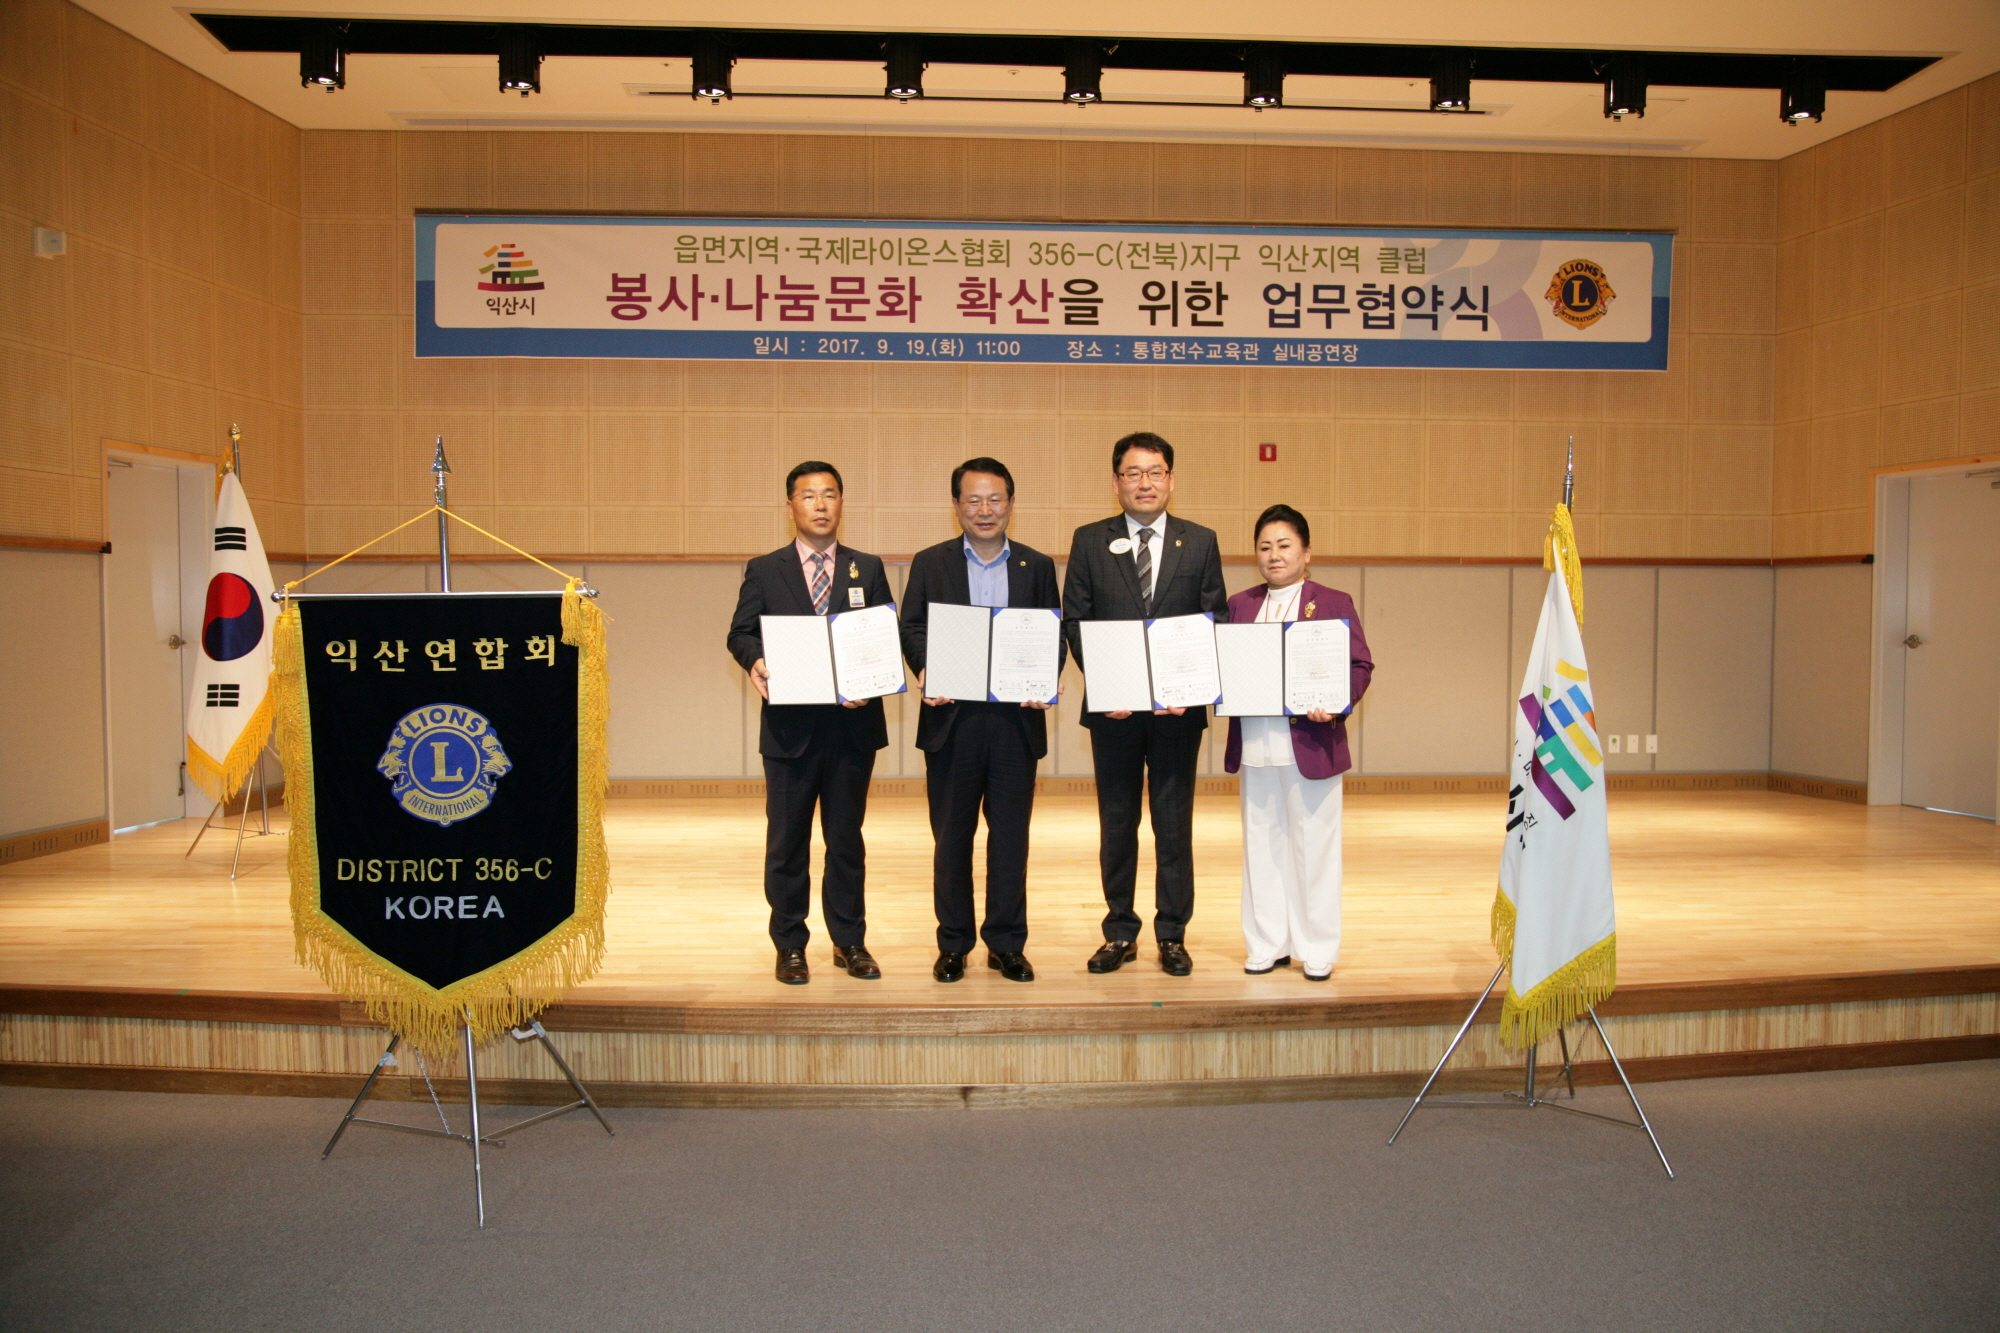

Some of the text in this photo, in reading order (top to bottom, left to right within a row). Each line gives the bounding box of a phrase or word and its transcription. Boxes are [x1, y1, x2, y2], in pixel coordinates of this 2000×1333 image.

[673, 234, 1426, 275] 읍면지역·국제라이온스협회 356-C(전북)지구 익산지역 클럽
[1563, 262, 1600, 277] LIONS
[606, 272, 1490, 332] 봉사·나눔문화 확산을 위한 업무협약식
[1570, 280, 1591, 307] L
[486, 297, 536, 316] 익산시
[753, 336, 789, 355] 일시
[818, 338, 866, 355] 2017.
[877, 338, 895, 356] 9.
[906, 338, 964, 357] 19.(화)
[976, 340, 1021, 356] 11:00
[1067, 340, 1104, 360] 장소
[1132, 341, 1260, 361] 통합전수교육관
[1273, 343, 1359, 362] 실내공연장
[405, 708, 483, 733] LIONS
[429, 741, 465, 783] L
[407, 793, 484, 817] INTERNATIONAL
[337, 857, 553, 883] DISTRICT 356-C
[385, 895, 506, 920] KOREA
